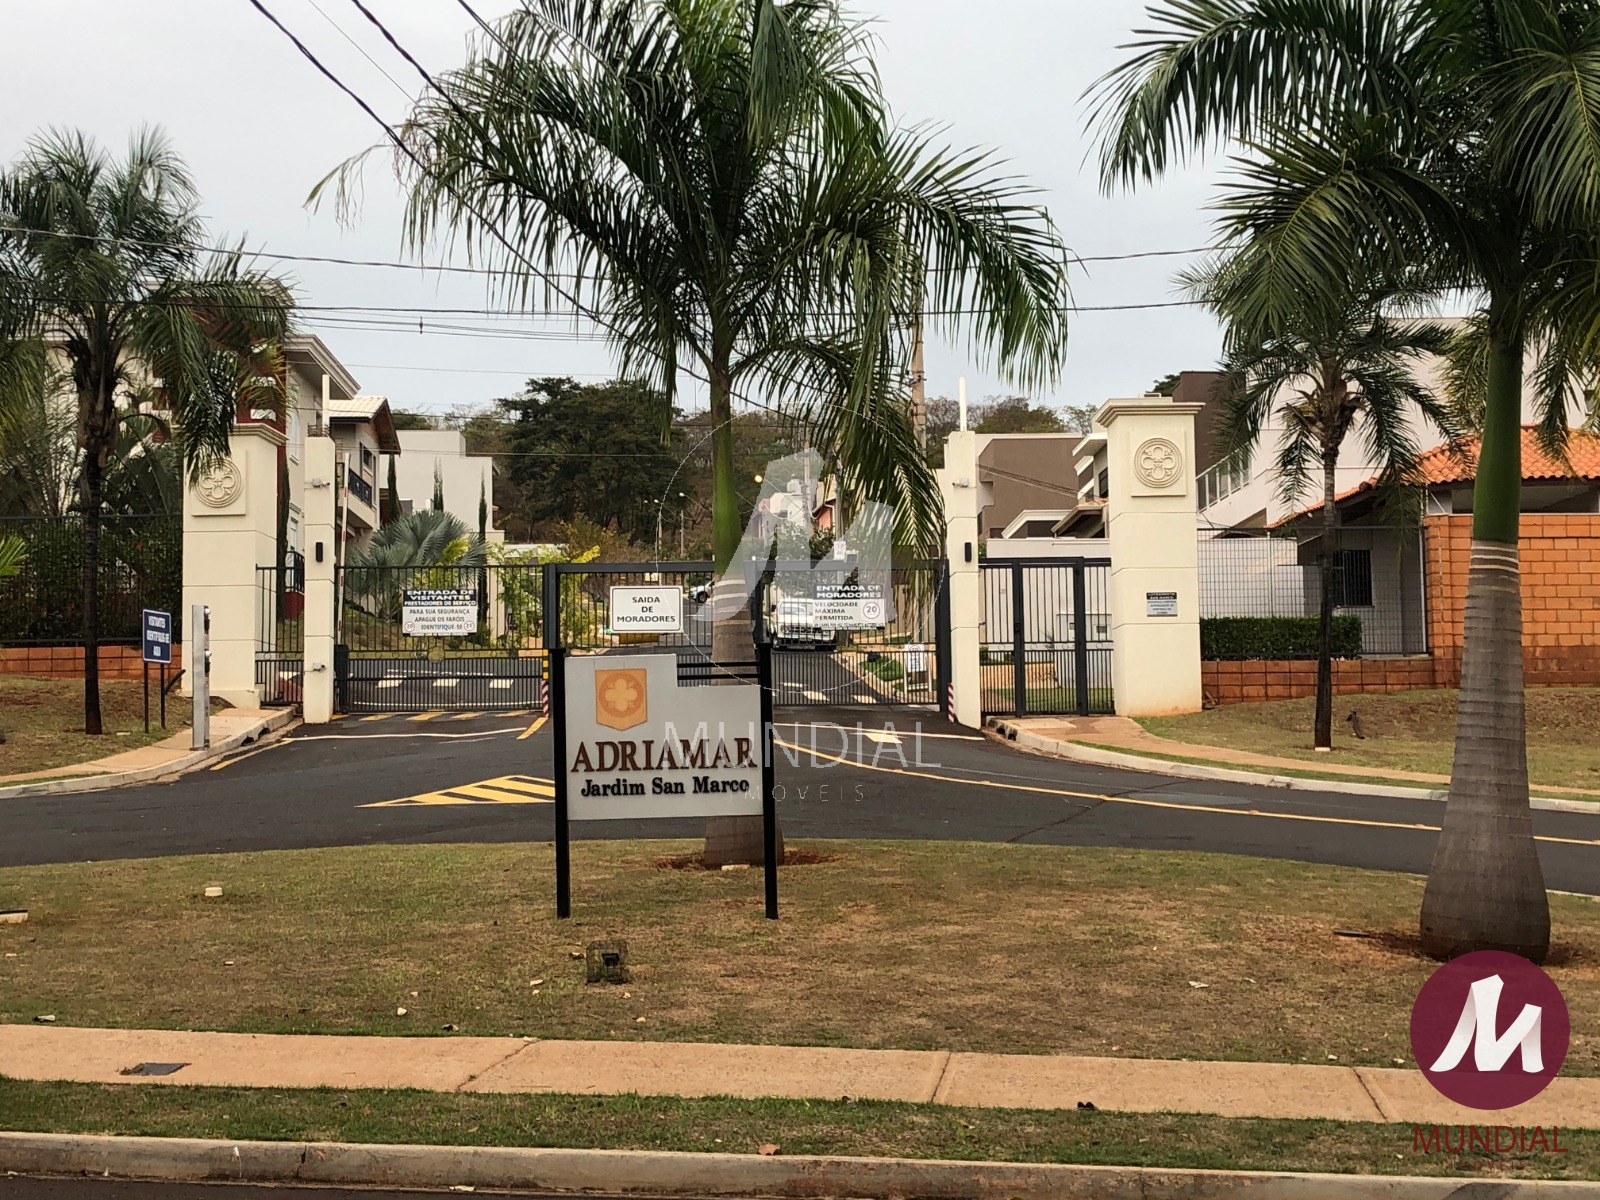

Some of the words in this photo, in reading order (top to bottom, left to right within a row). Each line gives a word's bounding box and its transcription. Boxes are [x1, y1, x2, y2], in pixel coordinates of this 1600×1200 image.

[866, 605, 878, 613] 20
[570, 737, 758, 772] ADRIAMAR
[581, 778, 646, 797] Jardim
[652, 777, 685, 795] San
[692, 776, 750, 793] Marco
